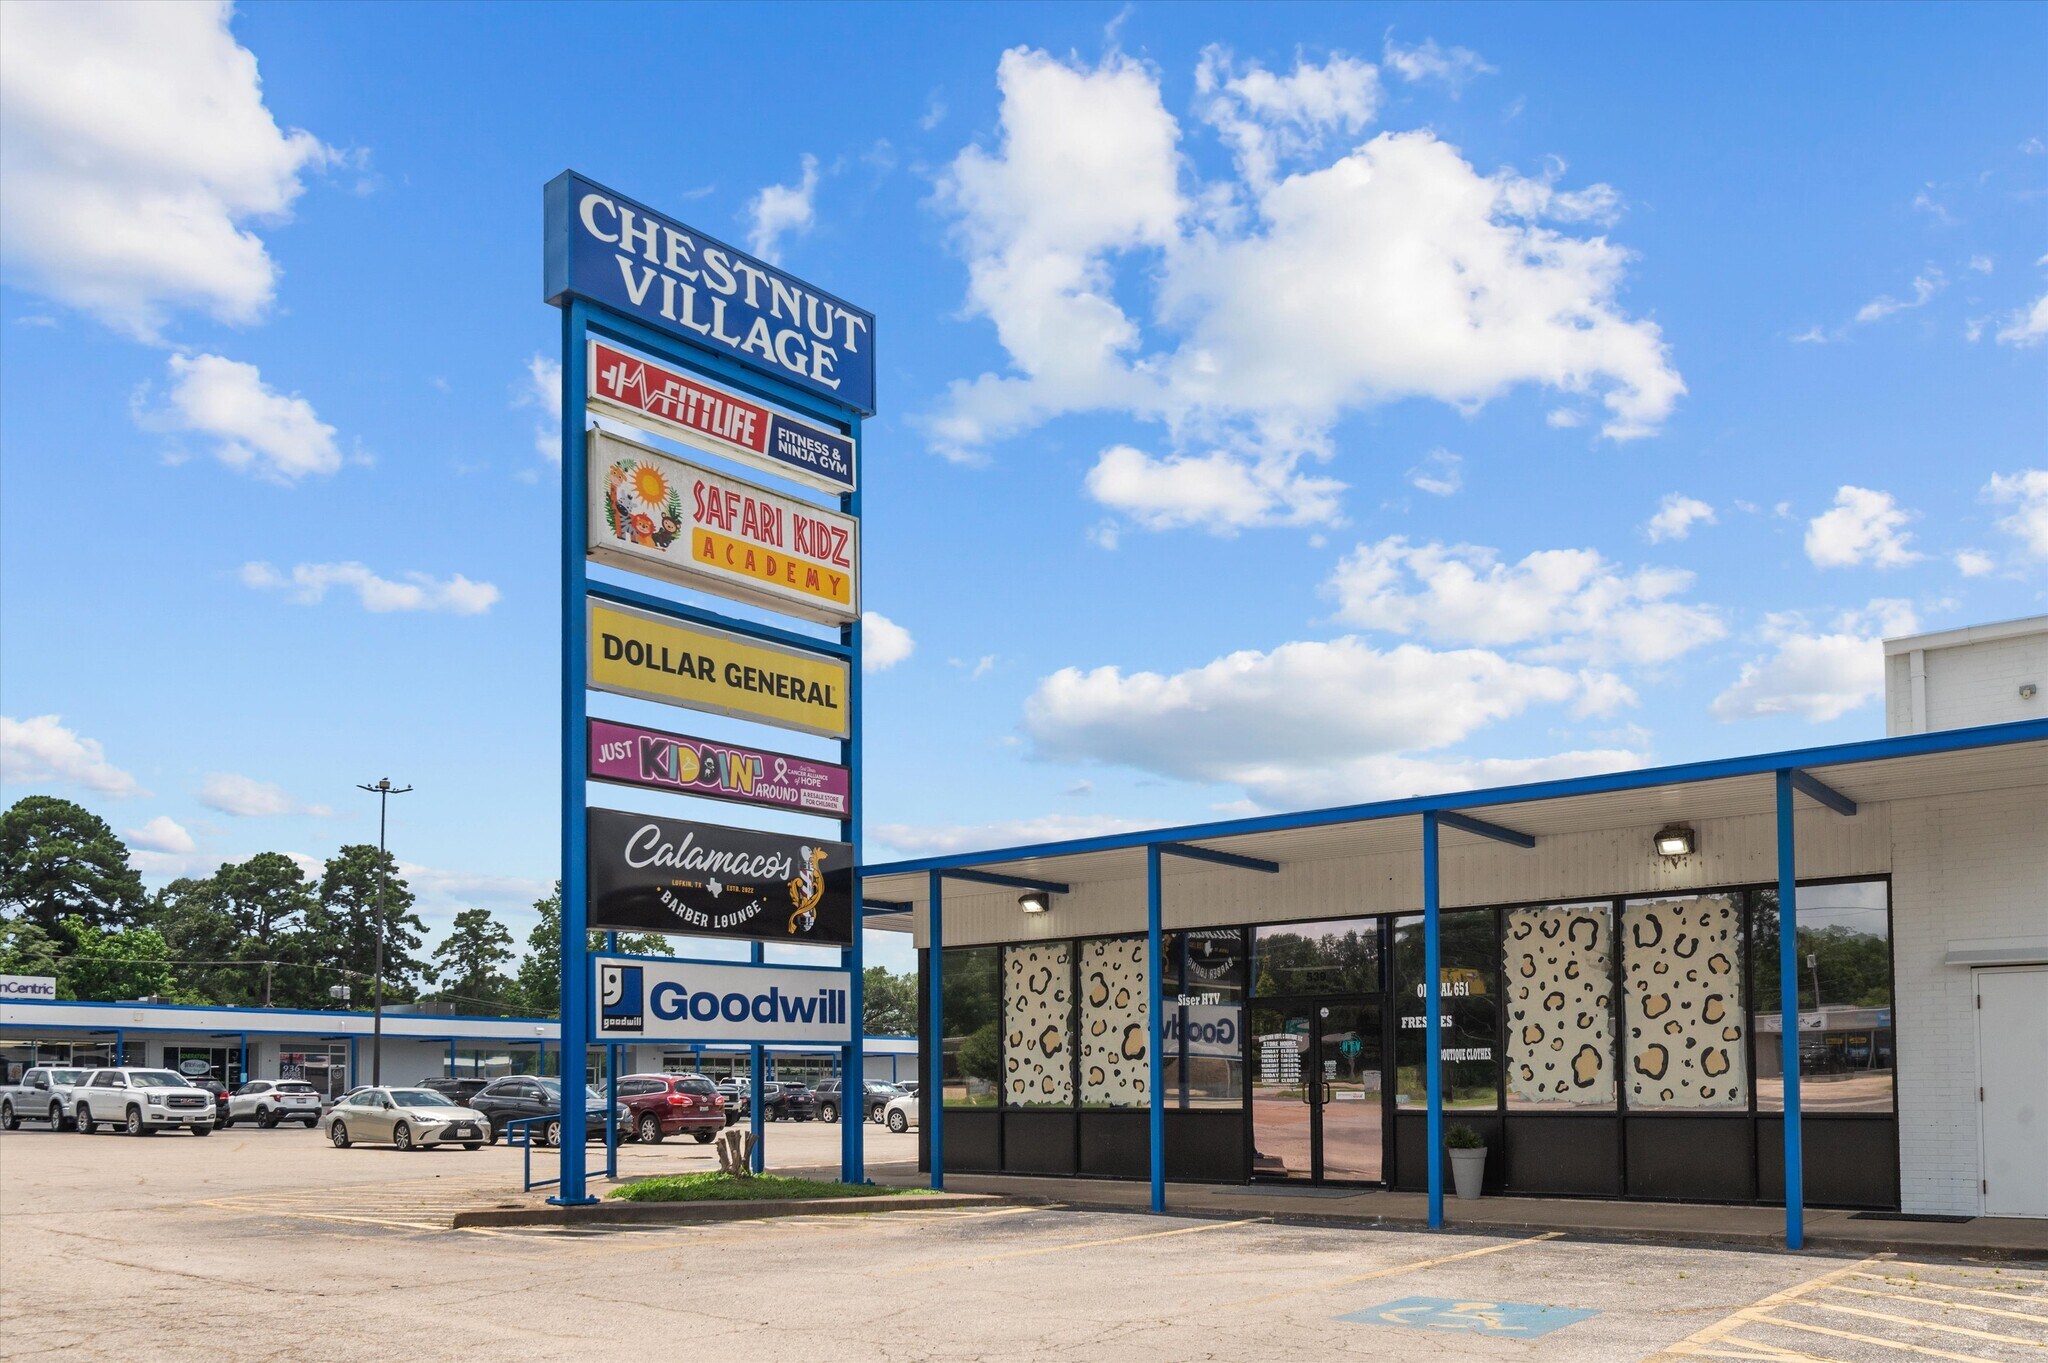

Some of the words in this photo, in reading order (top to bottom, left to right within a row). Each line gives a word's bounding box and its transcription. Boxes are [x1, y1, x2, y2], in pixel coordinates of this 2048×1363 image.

[578, 193, 867, 354] CHESTNUT
[615, 254, 841, 391] VILLAGE
[661, 379, 757, 446] FITTLIFE
[778, 427, 829, 457] FITNESS
[831, 448, 841, 461] &
[778, 442, 817, 465] NINJA
[820, 456, 848, 475] GYM
[693, 479, 784, 548] SAFARI
[794, 513, 850, 569] KIDZ
[703, 536, 841, 596] ACADEMY
[602, 633, 716, 683] DOLLAR
[724, 662, 838, 709] GENERAL
[598, 740, 633, 764] JUST
[640, 738, 762, 794] KIDDIN'
[787, 769, 806, 777] CANCER
[807, 772, 829, 781] ALLIANCE
[794, 777, 800, 785] of
[801, 776, 822, 787] HOPE
[755, 783, 799, 802] AROUND
[807, 792, 824, 800] RESALE
[815, 800, 838, 809] CHILDREN
[624, 823, 793, 881] Calamaco's
[672, 879, 693, 888] LUFKIN,
[741, 886, 754, 894] 2022
[660, 889, 708, 928] BARBER
[713, 900, 762, 929] LOUNGE
[1306, 971, 1327, 982] 539
[1453, 981, 1470, 997] 651
[649, 981, 846, 1025] Goodwill
[1177, 993, 1200, 1007] Siser
[1201, 992, 1220, 1006] HTV
[603, 1016, 642, 1029] goodwill
[1401, 1015, 1453, 1029] FRESES
[1466, 1047, 1492, 1060] CLOTHES
[282, 1064, 301, 1072] 936
